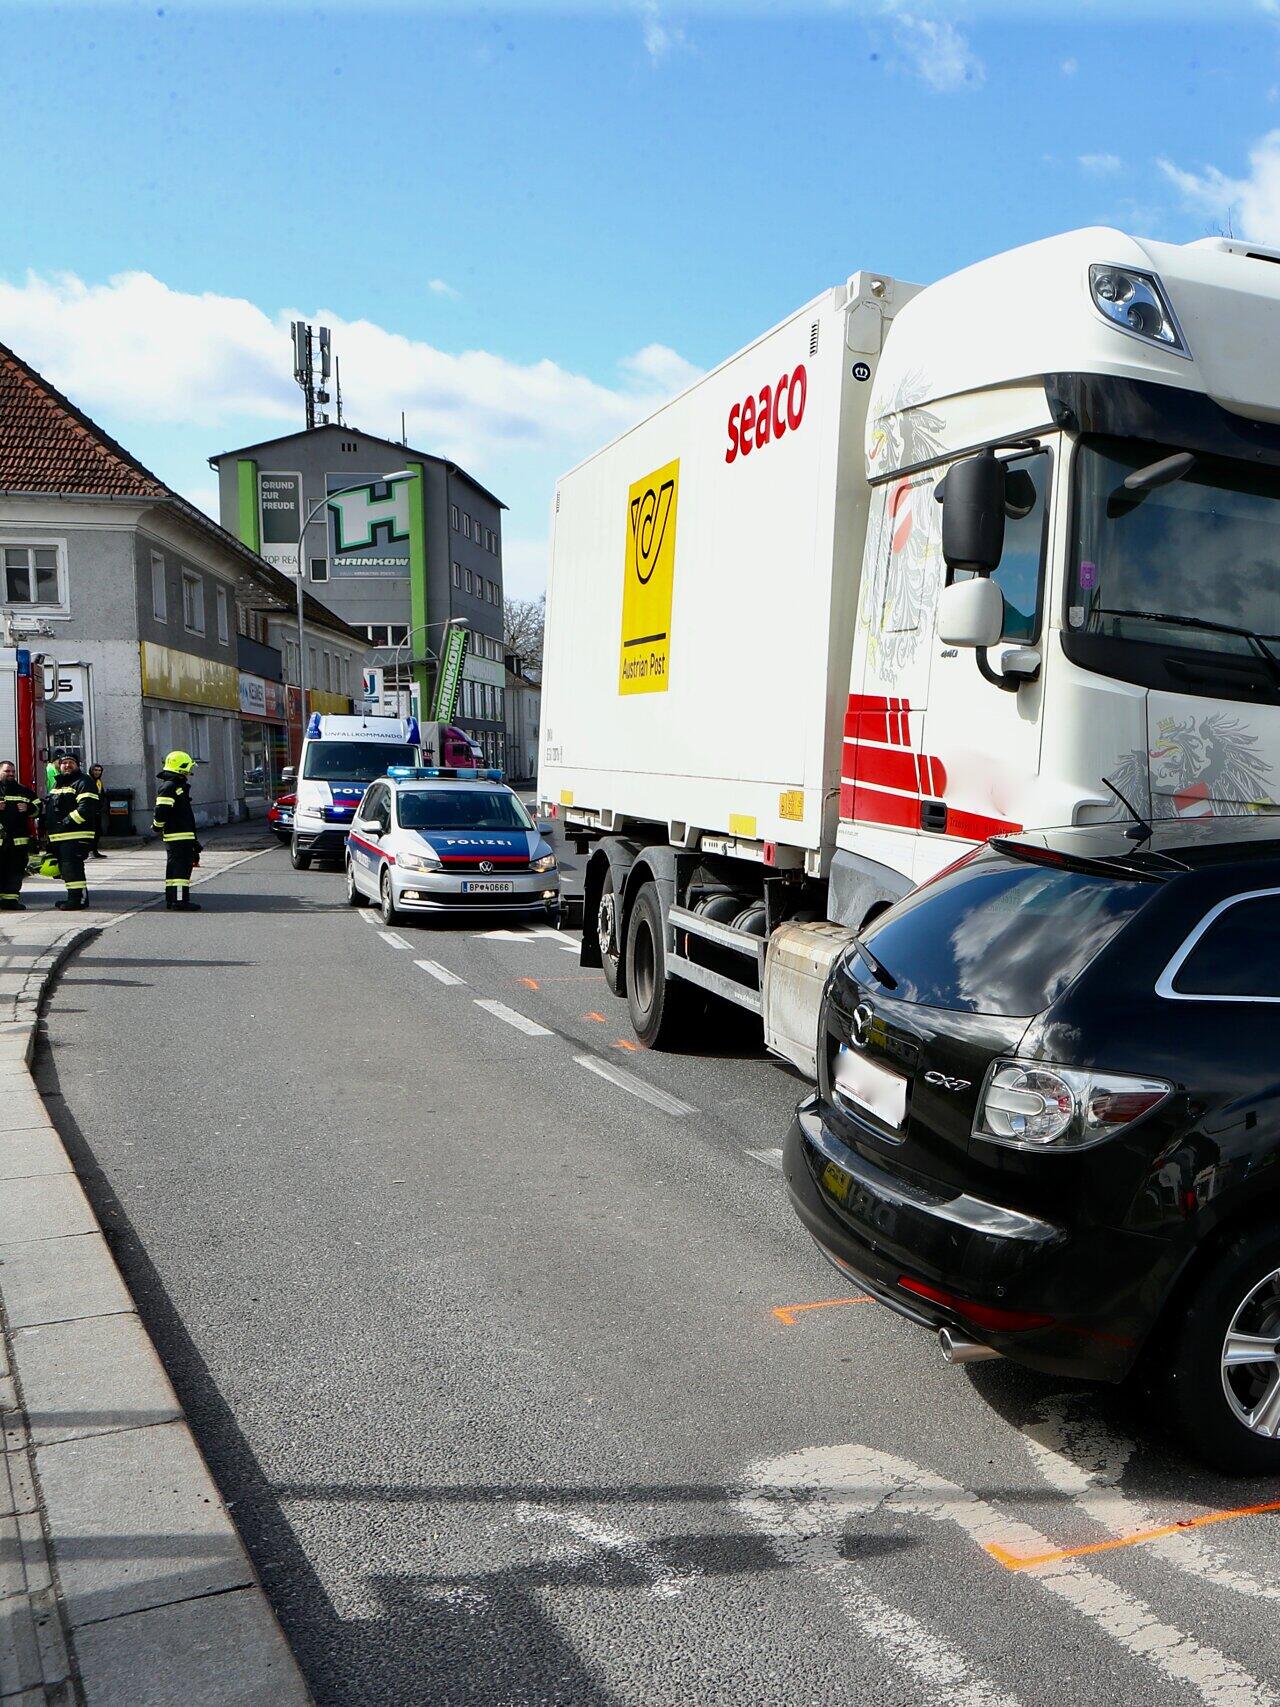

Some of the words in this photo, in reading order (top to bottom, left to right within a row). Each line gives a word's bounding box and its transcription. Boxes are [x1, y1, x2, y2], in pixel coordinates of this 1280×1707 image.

[725, 364, 807, 464] seaco
[262, 481, 295, 490] GRUND
[262, 491, 279, 499] ZUR
[262, 501, 295, 510] FREUDE
[263, 555, 279, 565] TOP
[282, 555, 298, 565] REA
[332, 557, 411, 567] HRINKOW
[621, 654, 648, 679] Austrian
[650, 652, 666, 677] Post
[324, 731, 403, 739] UNFALLKOMMANDO
[924, 1070, 972, 1091] CX-7
